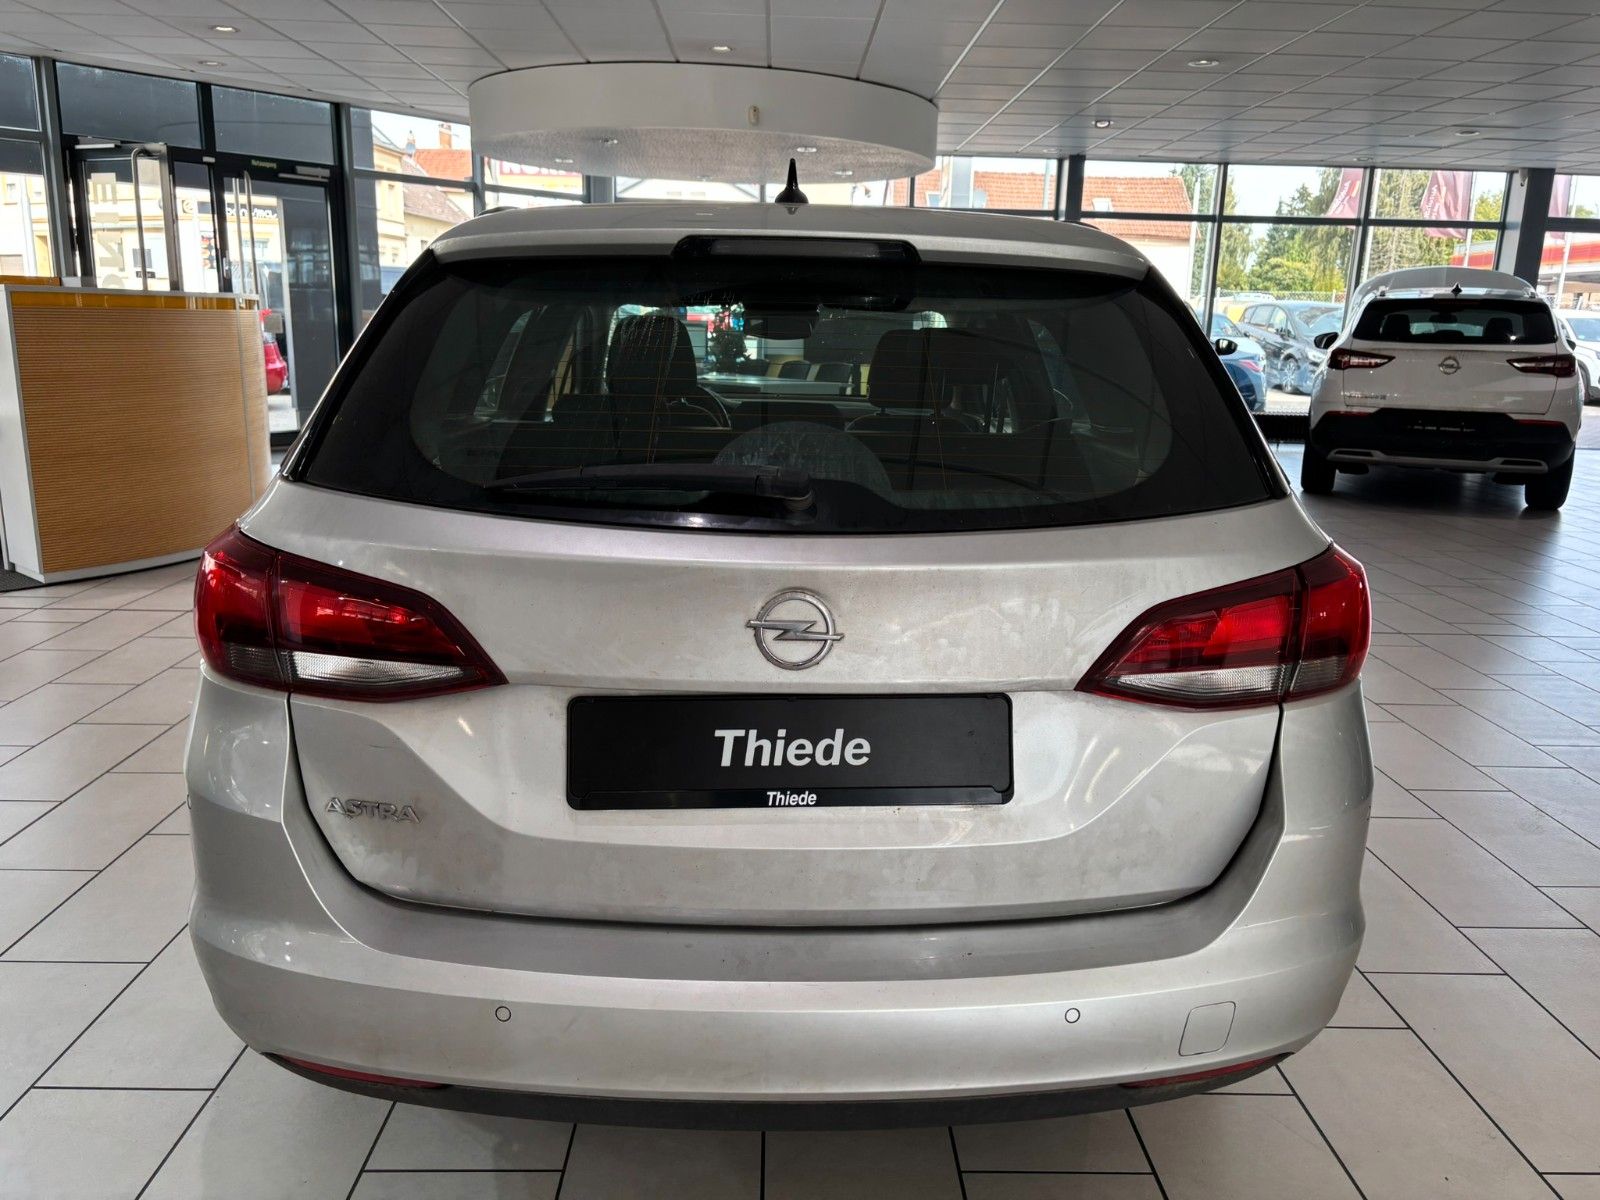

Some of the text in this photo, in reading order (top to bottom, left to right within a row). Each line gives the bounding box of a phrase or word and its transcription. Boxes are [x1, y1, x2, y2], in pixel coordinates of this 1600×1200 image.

[714, 728, 871, 767] Thiede
[326, 797, 421, 824] ASTRA
[766, 791, 817, 806] Thiede
